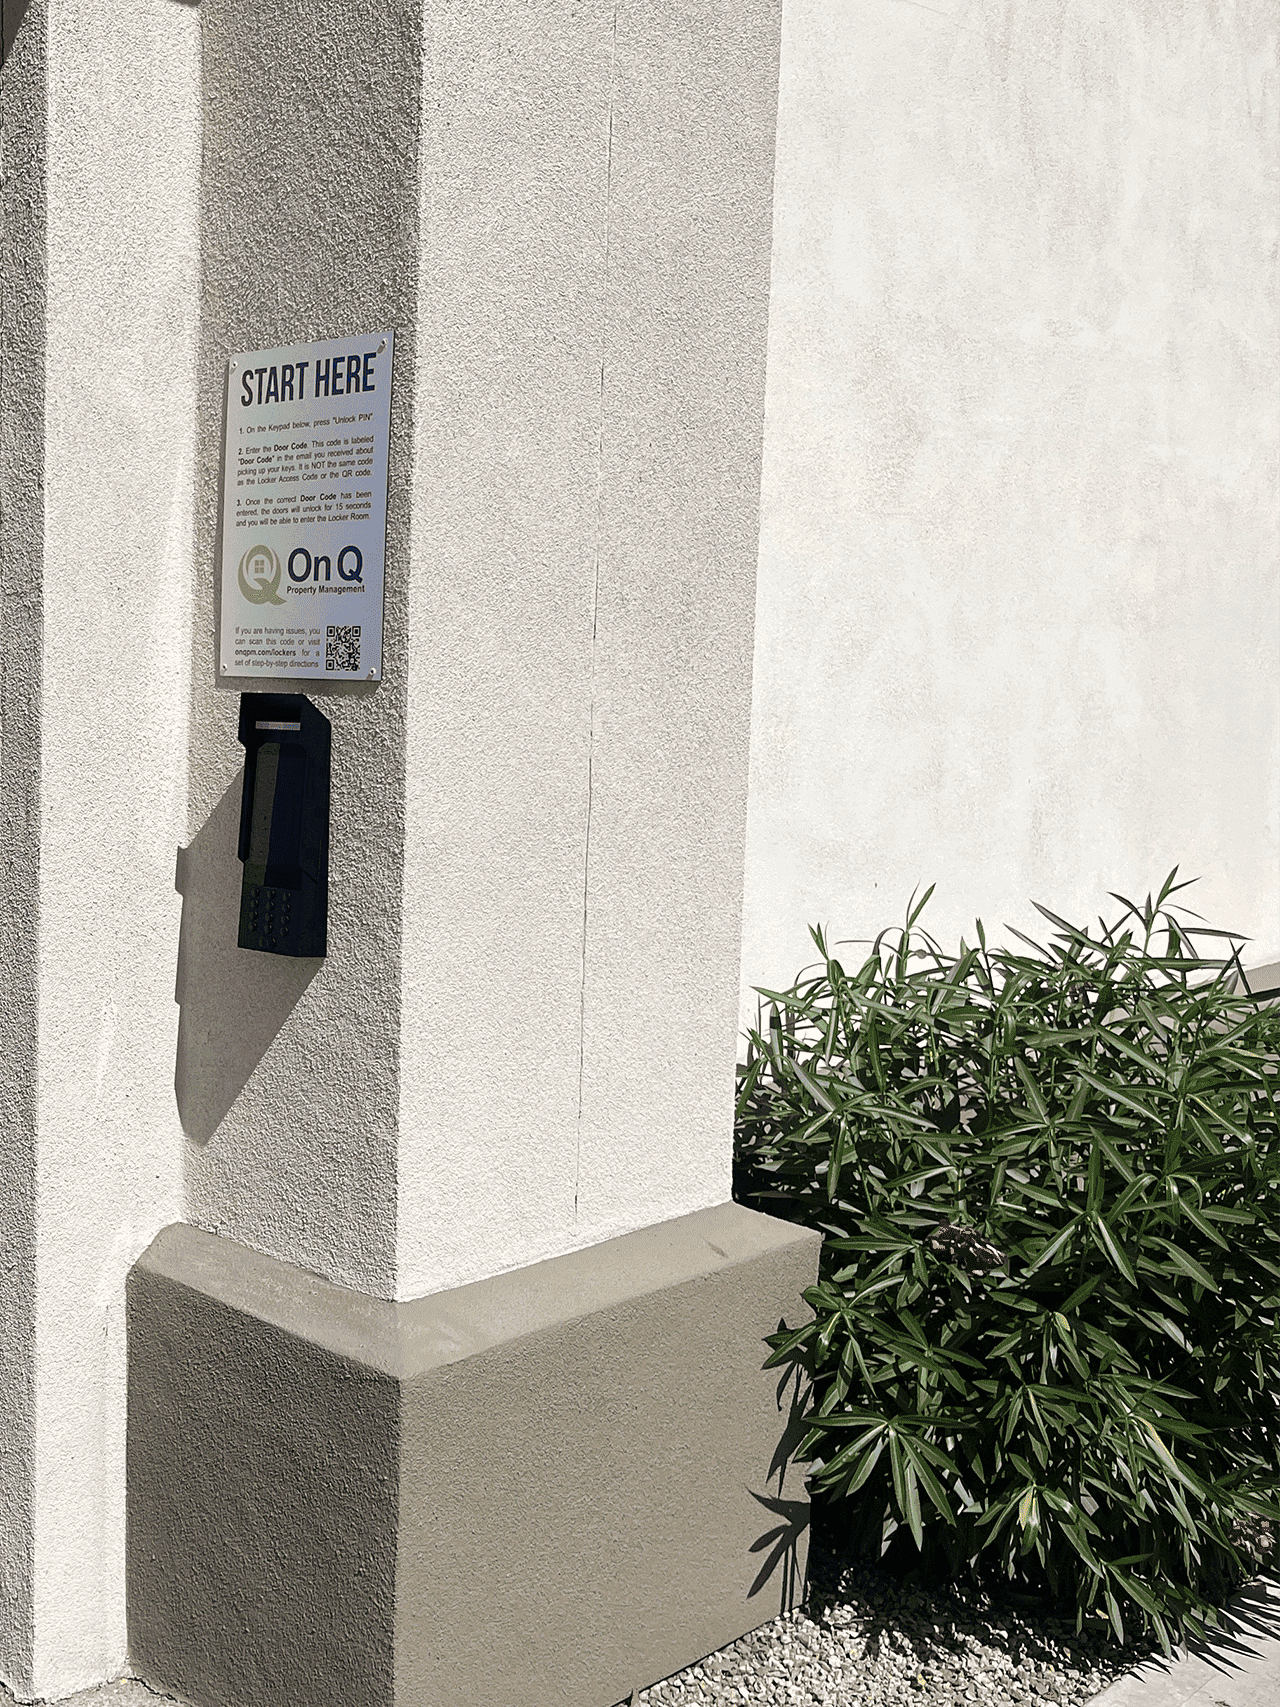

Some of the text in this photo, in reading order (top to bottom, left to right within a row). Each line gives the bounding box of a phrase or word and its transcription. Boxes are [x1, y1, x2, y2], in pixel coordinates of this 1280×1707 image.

[241, 352, 376, 406] START HERE
[268, 423, 290, 433] Keypad
[314, 419, 330, 427] press
[246, 446, 260, 454] Enter
[274, 444, 289, 452] Door
[312, 440, 324, 448] This
[326, 438, 341, 446] code
[351, 435, 374, 444] labeled
[238, 457, 254, 465] "Door
[256, 455, 274, 464] Code"
[284, 453, 294, 461] the
[296, 452, 311, 460] email
[314, 451, 325, 460] you
[327, 448, 353, 457] received
[355, 446, 374, 454] about
[238, 466, 256, 476] picking
[258, 466, 266, 474] up
[267, 465, 280, 474] your
[311, 461, 326, 469] NOT
[327, 460, 337, 468] the
[339, 459, 355, 467] same
[358, 457, 373, 466] code
[258, 476, 276, 485] Locker
[279, 474, 299, 482] Access
[302, 472, 318, 481] Code
[330, 471, 339, 479] the
[342, 469, 352, 478] QR
[246, 498, 260, 506] Once
[277, 495, 296, 503] correct
[300, 494, 316, 502] Door
[320, 493, 336, 501] Code
[356, 491, 372, 499] been
[272, 507, 289, 515] doors
[303, 504, 322, 512] unlock
[346, 501, 371, 510] seconds
[236, 519, 246, 527] and
[247, 520, 258, 528] you
[259, 518, 268, 526] will
[279, 517, 291, 525] able
[293, 516, 299, 524] to
[300, 516, 315, 524] enter
[317, 515, 326, 523] the
[328, 513, 349, 522] Locker
[288, 545, 363, 583] On Q
[287, 585, 365, 595] Property Management
[264, 627, 284, 636] having
[309, 627, 320, 635] you
[266, 637, 276, 645] this
[280, 638, 295, 646] code
[298, 638, 304, 646] or
[308, 637, 320, 645] visit
[252, 659, 287, 668] step-by-step
